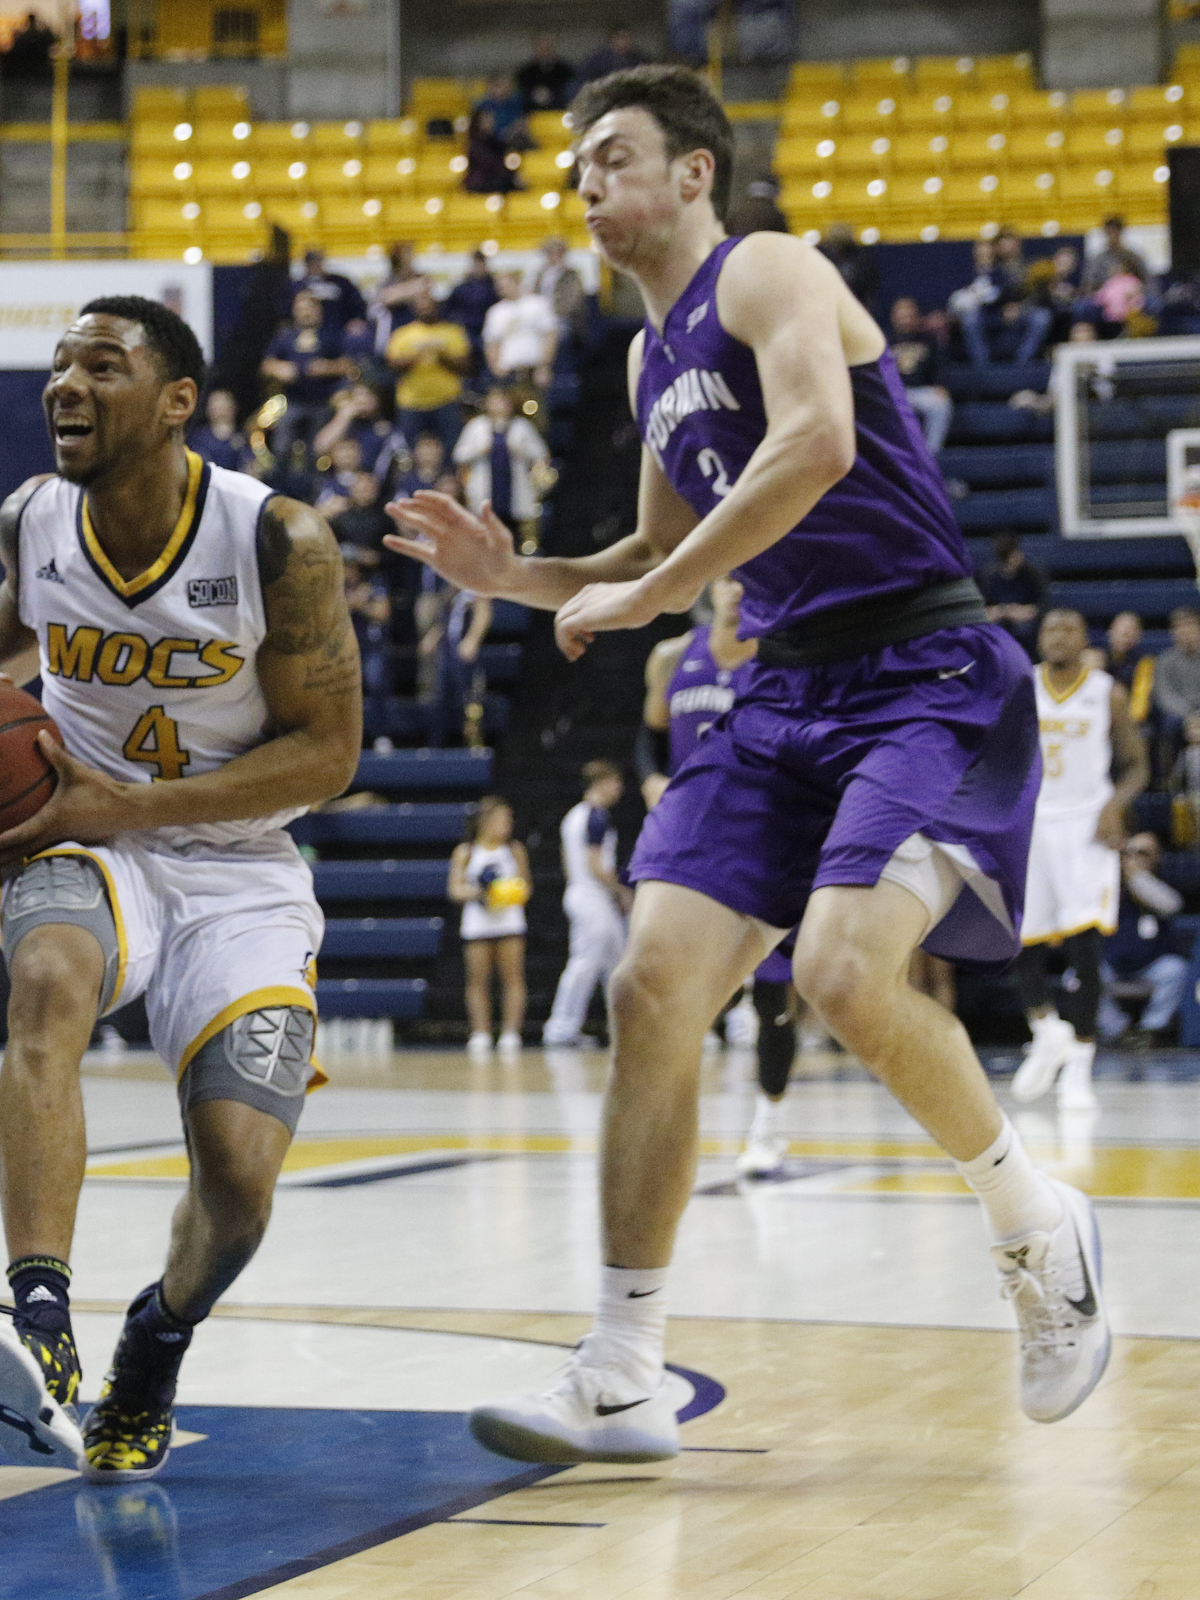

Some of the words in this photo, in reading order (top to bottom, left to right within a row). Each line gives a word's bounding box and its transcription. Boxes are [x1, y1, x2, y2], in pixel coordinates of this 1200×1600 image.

[697, 447, 736, 496] 2
[188, 575, 239, 608] SOCON
[47, 622, 246, 689] MOCS
[122, 705, 191, 782] 4
